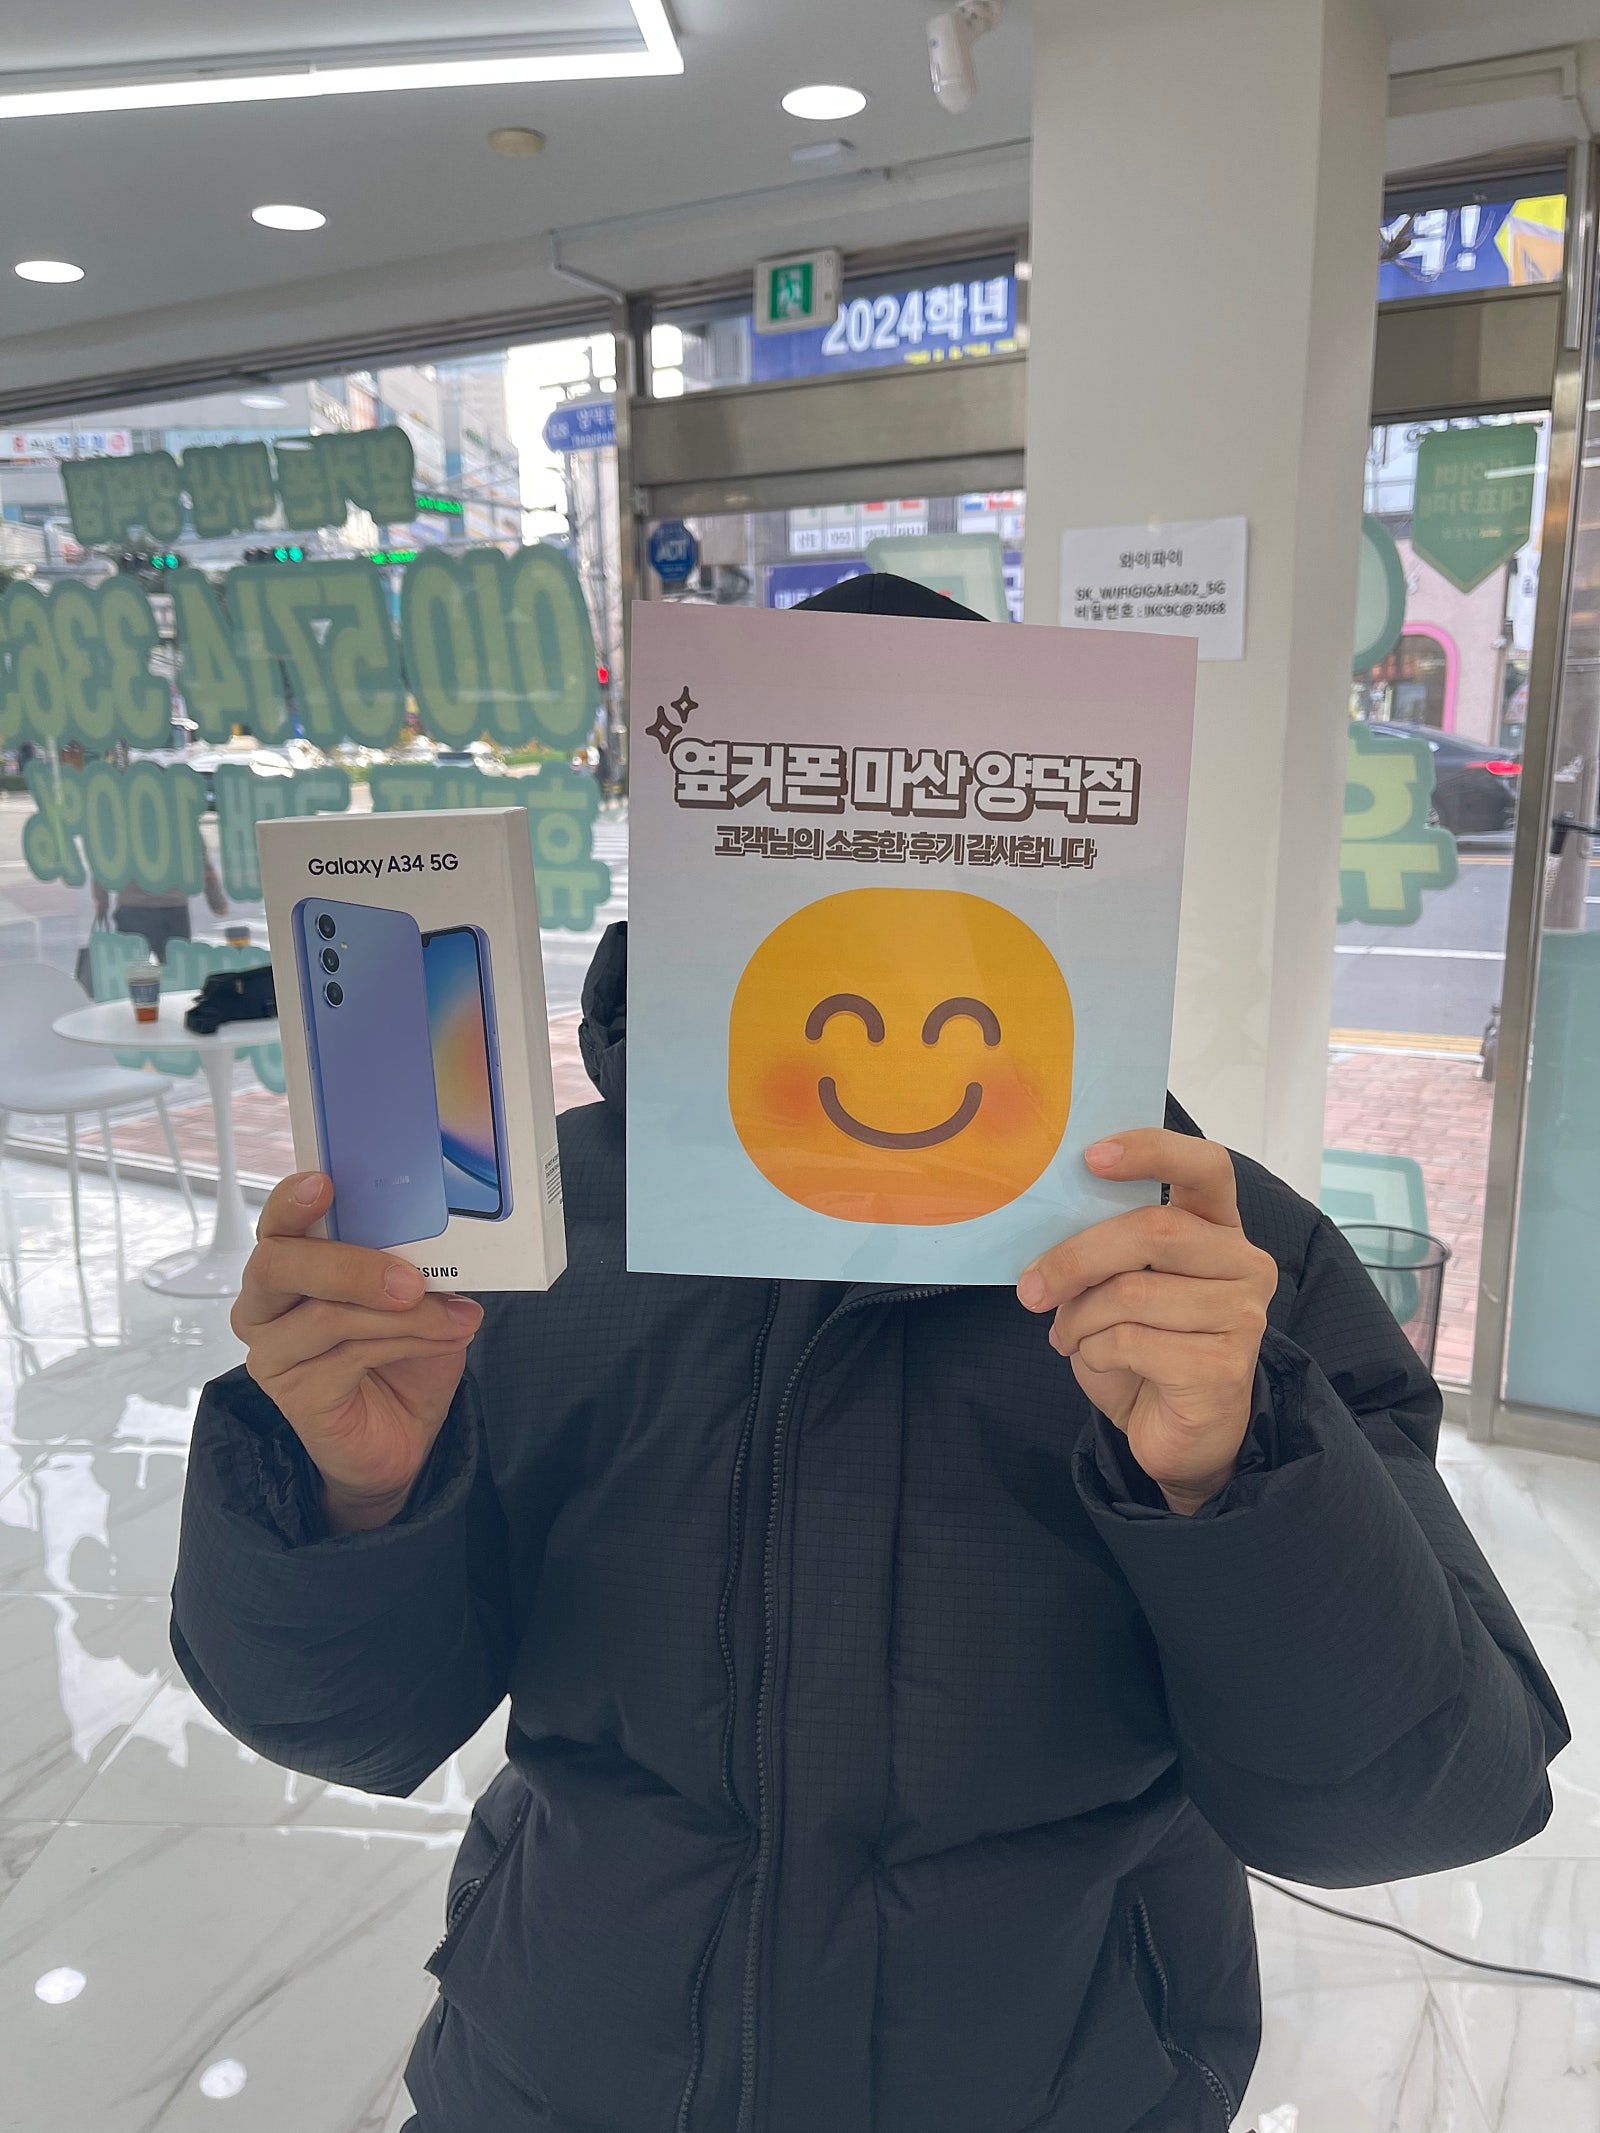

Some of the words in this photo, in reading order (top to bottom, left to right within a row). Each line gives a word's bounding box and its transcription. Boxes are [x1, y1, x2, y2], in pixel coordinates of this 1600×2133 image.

[1119, 549, 1183, 570] 와이파이
[671, 738, 847, 814] 옆커폰
[852, 747, 973, 819] 마산
[975, 750, 1142, 825] 양덕점
[714, 825, 822, 859] 고객님의
[825, 829, 908, 864] 소중한
[909, 833, 963, 865] 후기
[965, 834, 1097, 869] 감사합니다
[308, 858, 384, 878] Galaxy
[387, 855, 425, 872] A34
[430, 853, 459, 871] 5G
[416, 1267, 459, 1278] SUNG
